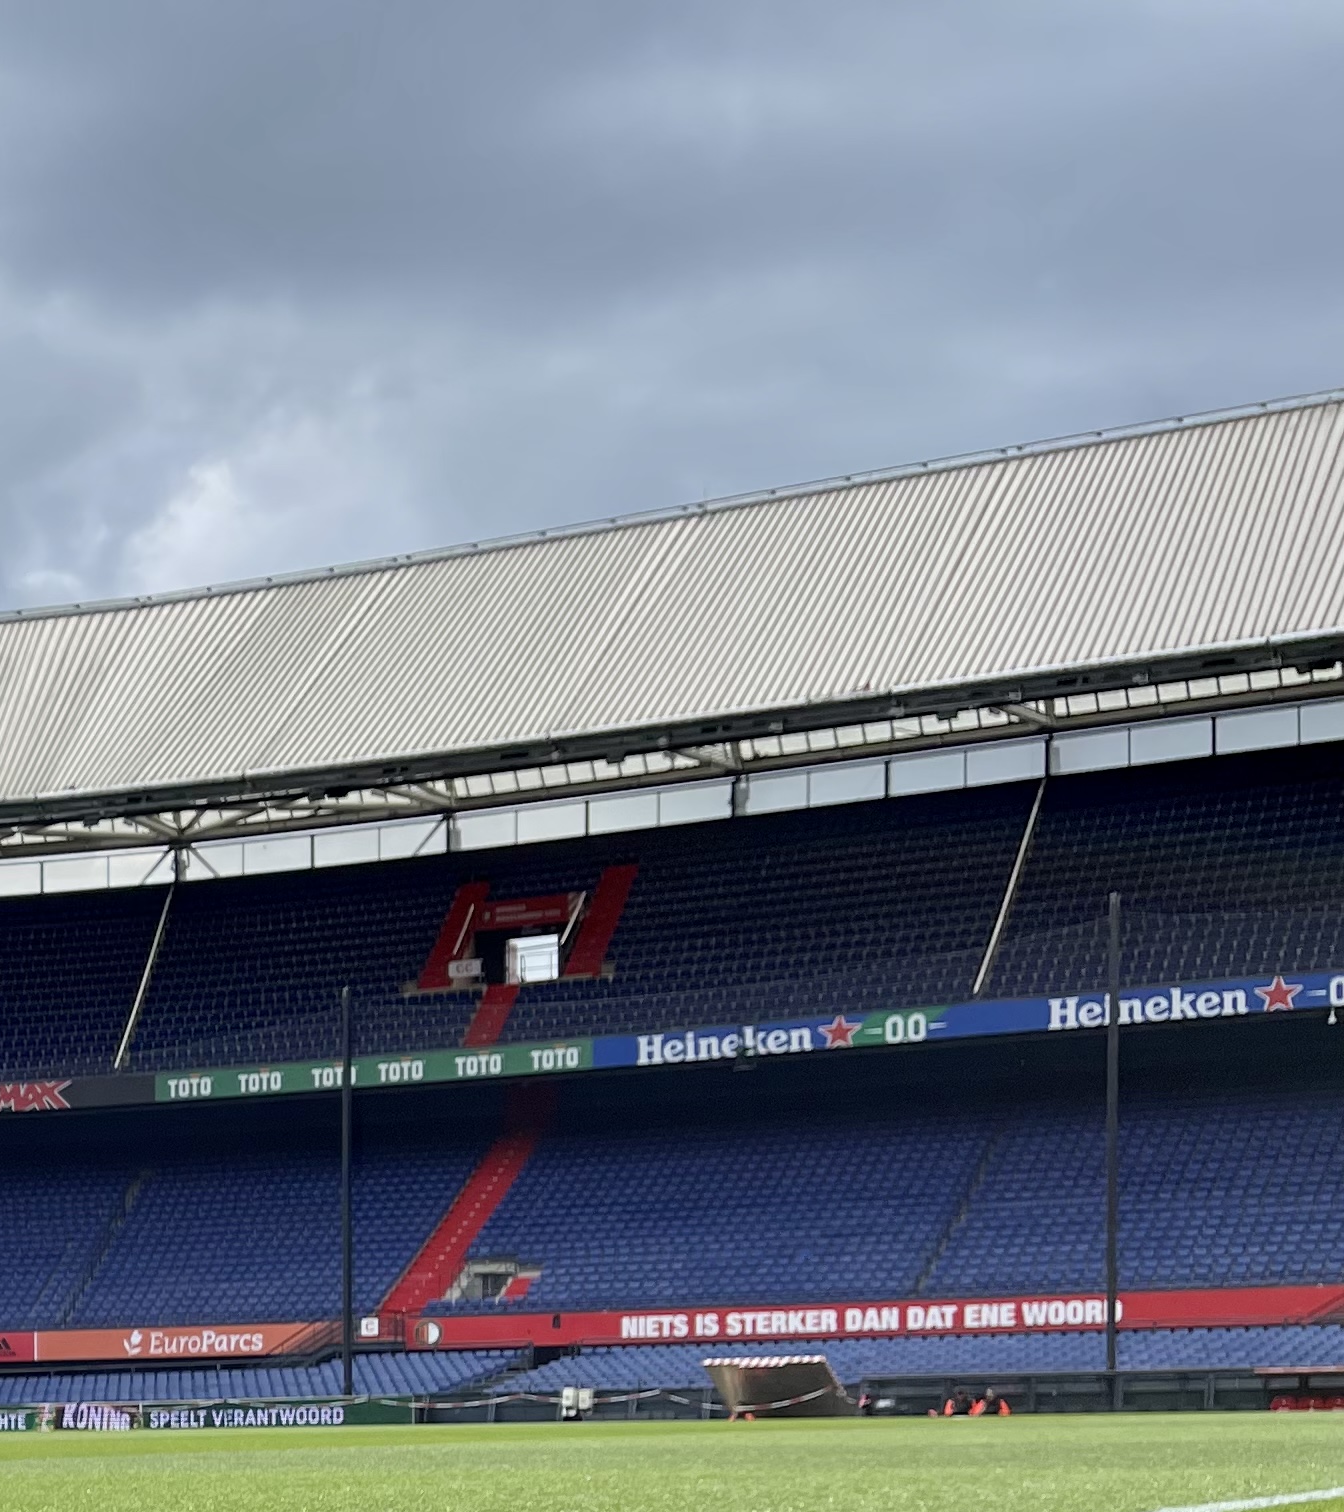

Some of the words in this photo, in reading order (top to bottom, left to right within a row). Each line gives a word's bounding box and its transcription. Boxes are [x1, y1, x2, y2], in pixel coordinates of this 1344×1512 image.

[1047, 987, 1249, 1031] Heineken
[637, 1025, 813, 1066] Heineken
[455, 1054, 502, 1077] TOTO
[531, 1046, 579, 1071] TOTO
[238, 1071, 282, 1093] TOTO
[378, 1060, 423, 1082] TOTO
[168, 1076, 211, 1098] TOTO
[621, 1314, 689, 1339] NIETS
[695, 1312, 720, 1337] IS
[725, 1309, 838, 1336] STERKER
[844, 1307, 900, 1333] DAN
[906, 1304, 958, 1330] DAT
[964, 1302, 1017, 1328] ENE
[1022, 1298, 1123, 1327] WOORD
[149, 1330, 263, 1354] EuroParcs
[61, 1403, 131, 1431] KONING
[150, 1409, 207, 1428] SPEELT
[211, 1407, 345, 1428] VERANTWOORD
